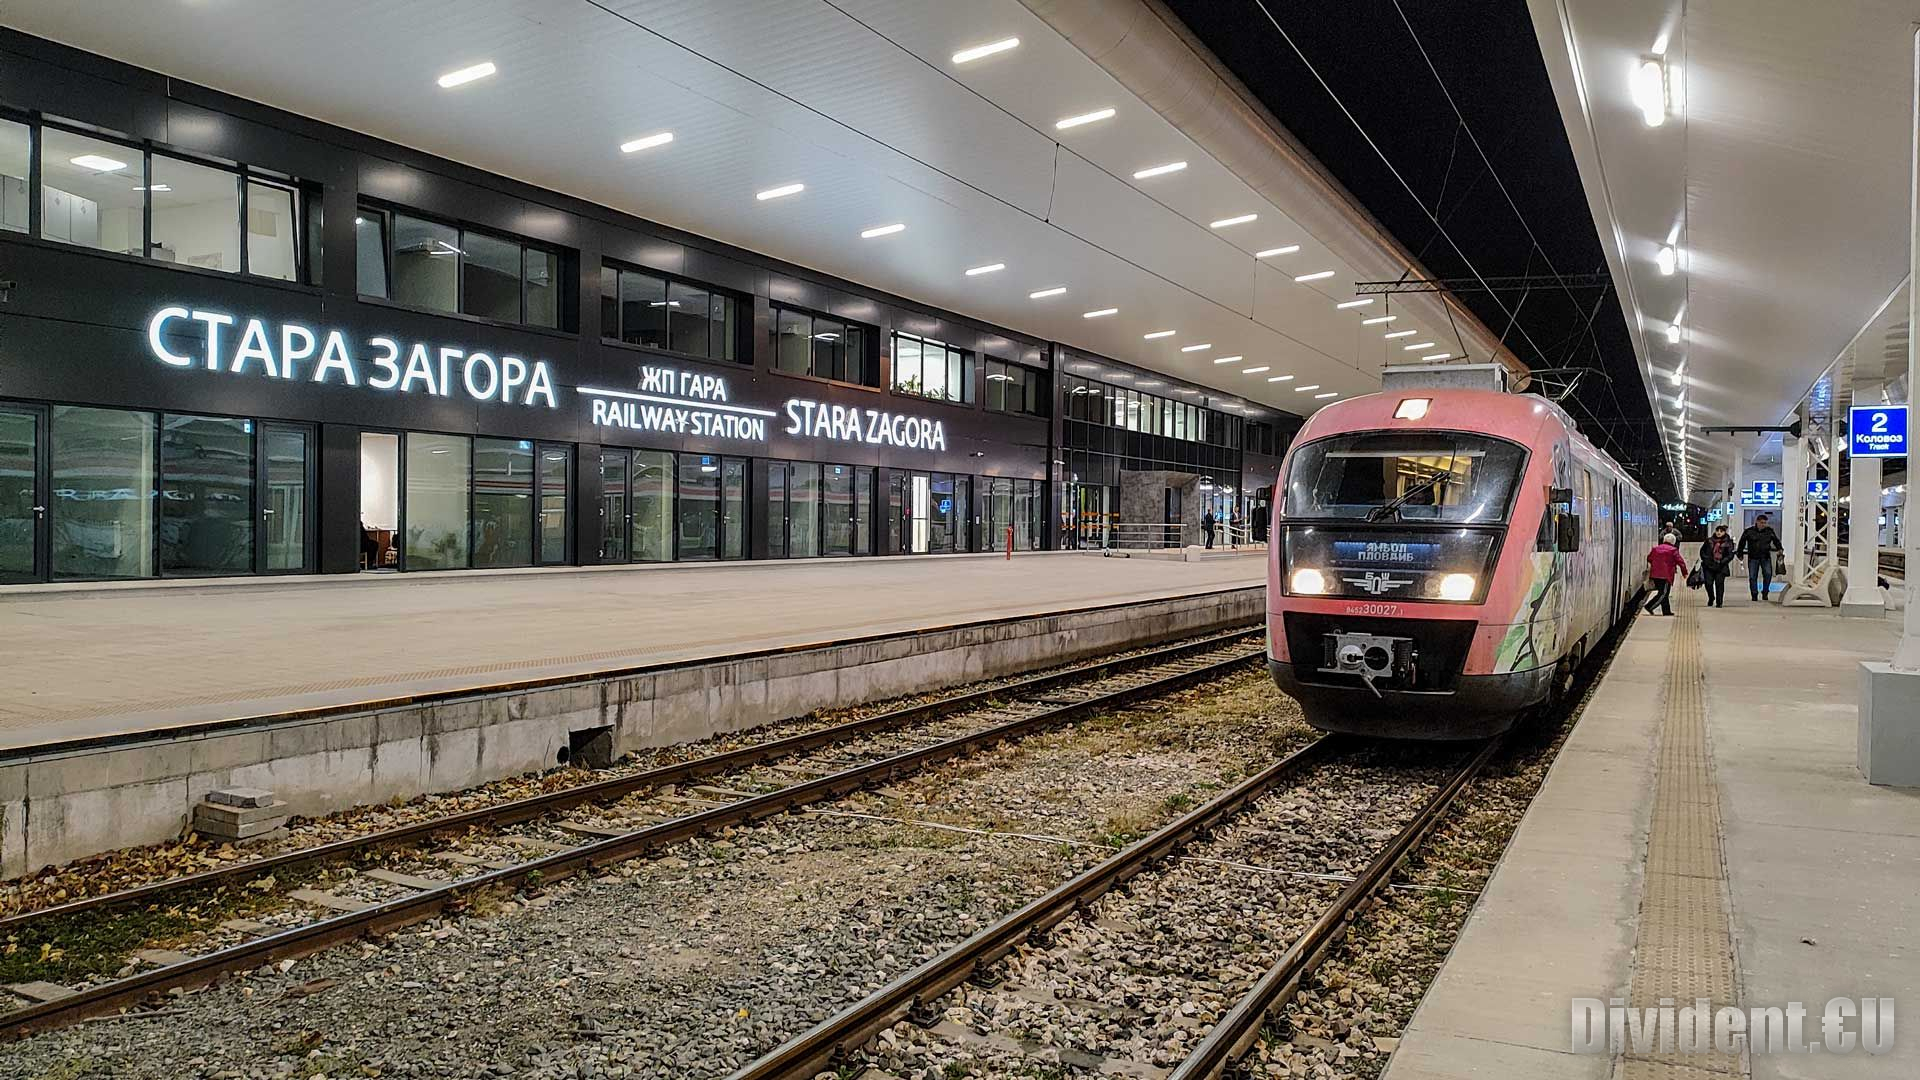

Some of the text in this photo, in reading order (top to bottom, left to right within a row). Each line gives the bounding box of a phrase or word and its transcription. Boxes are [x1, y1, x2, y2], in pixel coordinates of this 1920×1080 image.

[148, 306, 557, 408] СТАРА ЗАГОРА
[641, 366, 727, 401] ЖП ГАРА
[592, 399, 764, 441] RAILWAY STATION
[785, 399, 945, 451] STARA ZAGORA
[1871, 412, 1888, 433] 2
[1856, 433, 1903, 444] Коловоз
[1761, 483, 1769, 492] 2
[1815, 482, 1823, 492] 3
[1366, 542, 1407, 553] ЯМБОЛ
